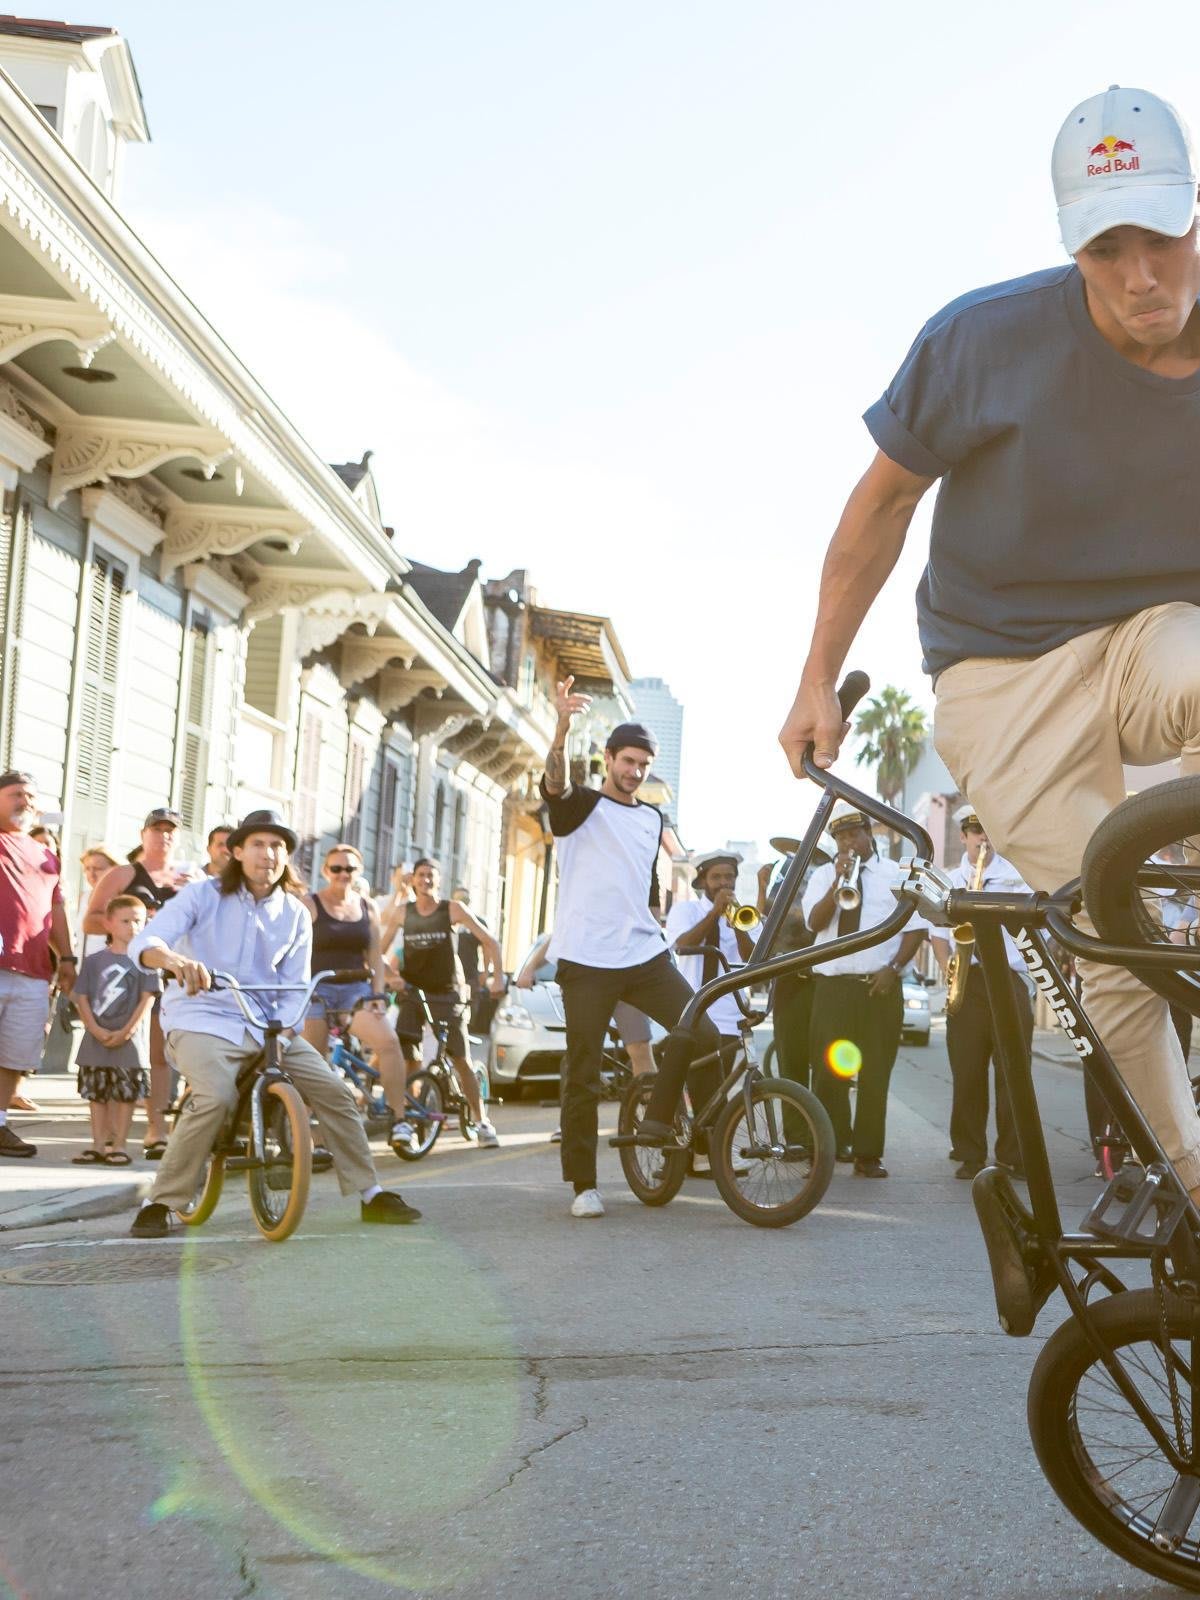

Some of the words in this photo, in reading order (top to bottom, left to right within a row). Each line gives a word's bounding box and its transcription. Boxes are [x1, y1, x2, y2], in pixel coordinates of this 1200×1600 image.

[1087, 159, 1112, 177] Red
[1114, 156, 1140, 171] Bull
[1011, 926, 1094, 1058] G-SHOCK
